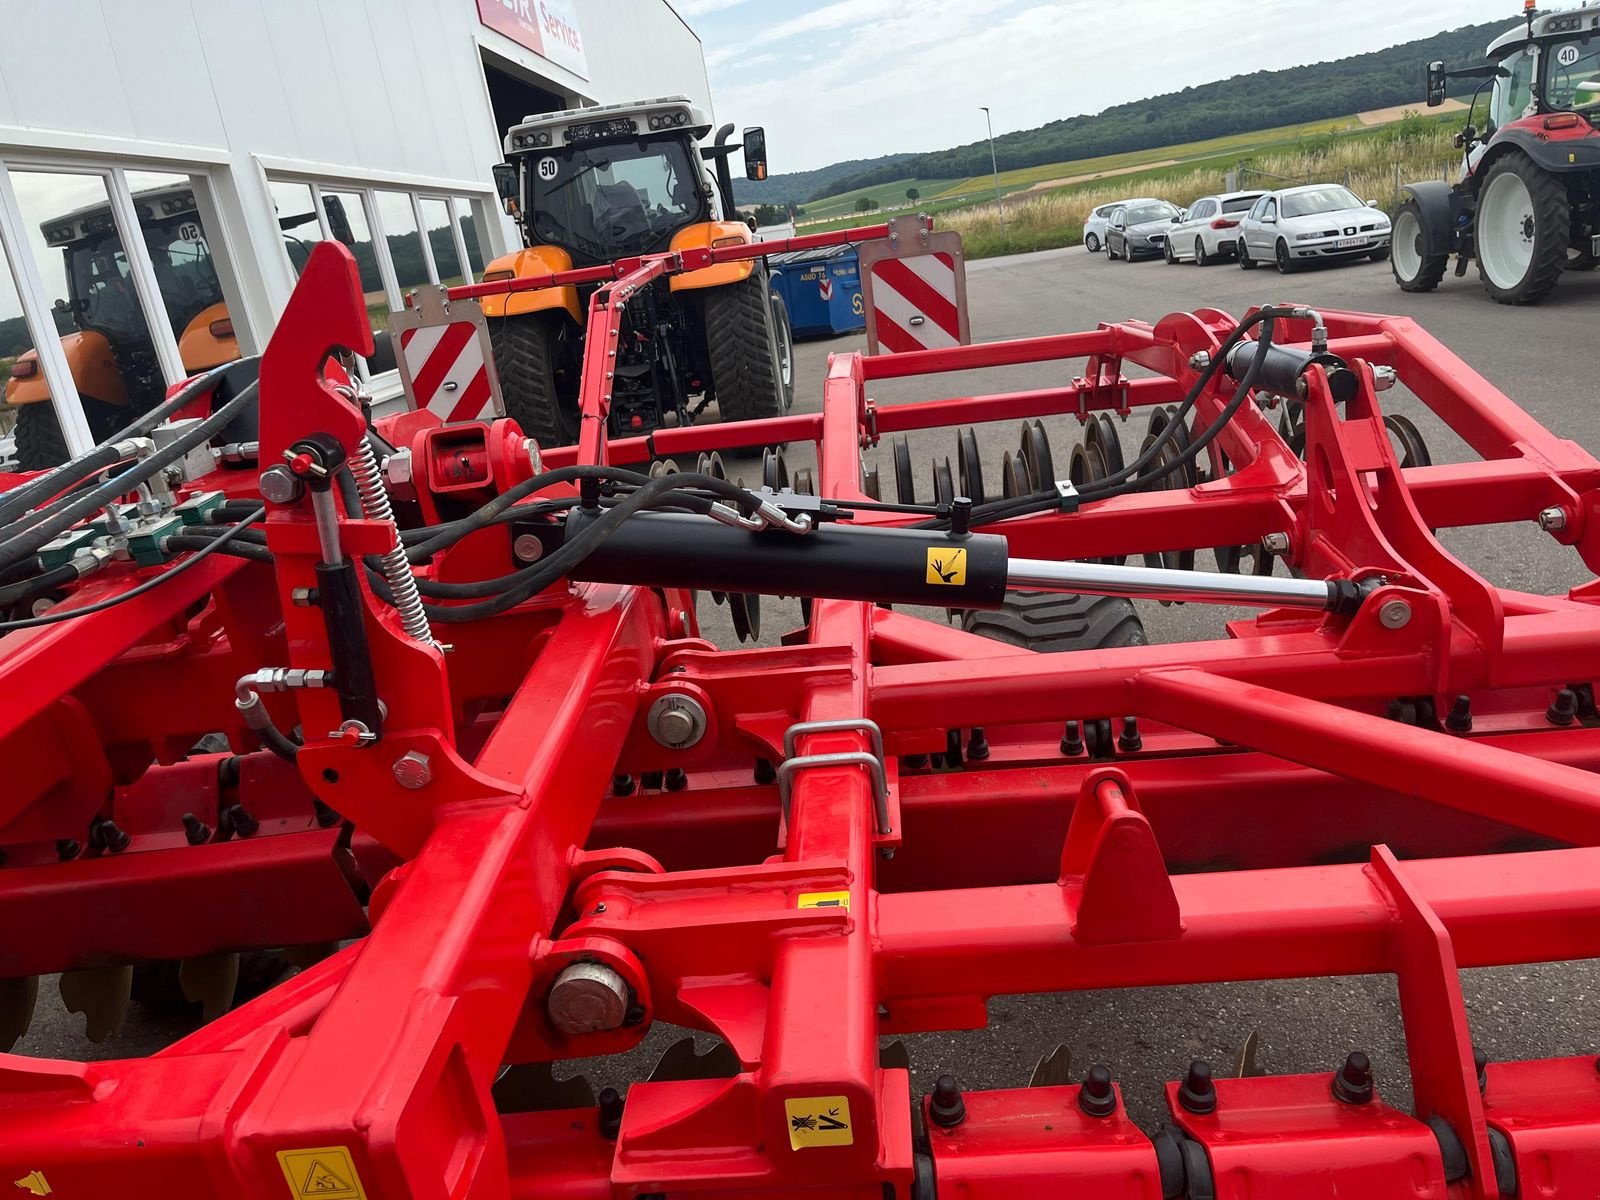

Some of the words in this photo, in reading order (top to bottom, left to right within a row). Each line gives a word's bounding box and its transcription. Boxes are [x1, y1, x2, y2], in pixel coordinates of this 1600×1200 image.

[540, 1, 580, 52] Service
[1561, 49, 1575, 62] 40
[541, 160, 555, 176] 50
